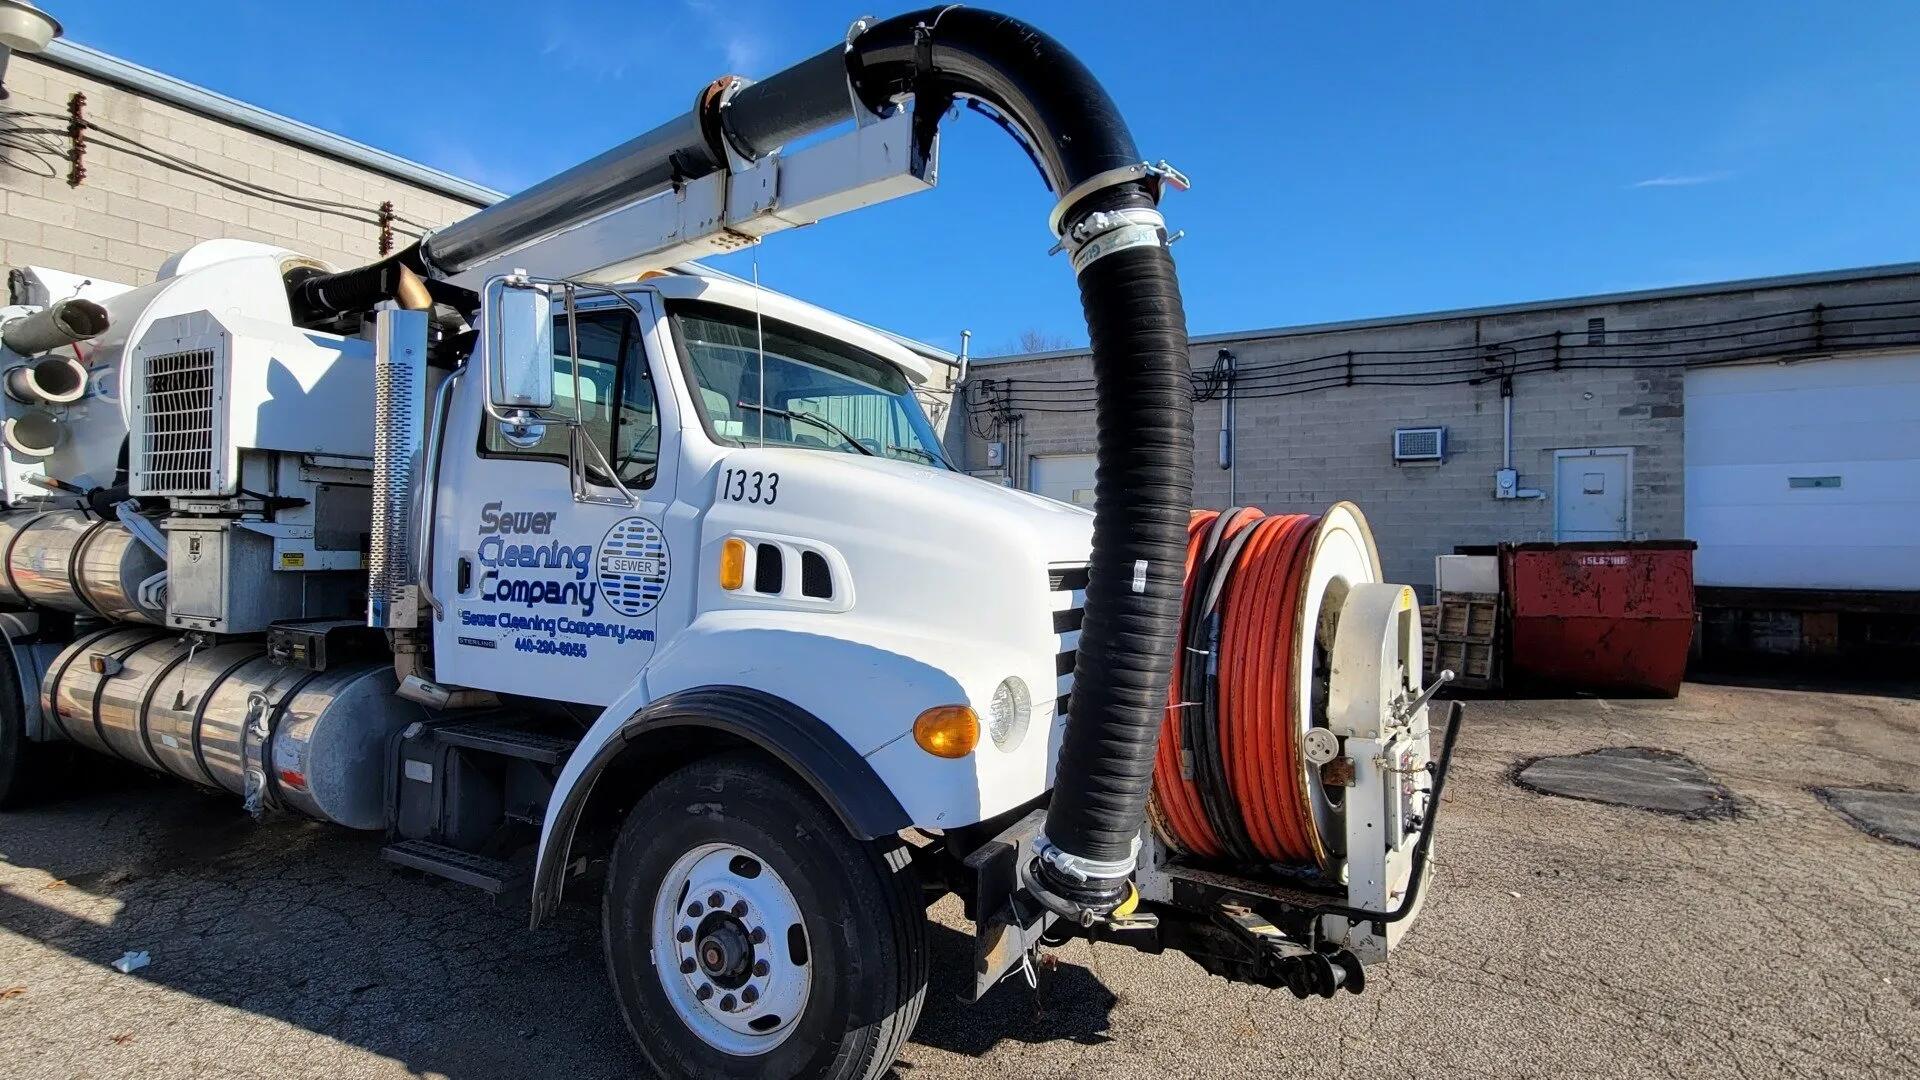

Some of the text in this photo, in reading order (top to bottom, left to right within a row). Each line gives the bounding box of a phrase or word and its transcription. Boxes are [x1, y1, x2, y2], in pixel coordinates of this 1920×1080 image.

[723, 469, 780, 505] 1333
[478, 500, 557, 535] Sewer
[478, 535, 592, 580] Cleaning
[614, 560, 652, 573] SEWER
[479, 569, 597, 617] Company
[459, 638, 495, 648] STERLING
